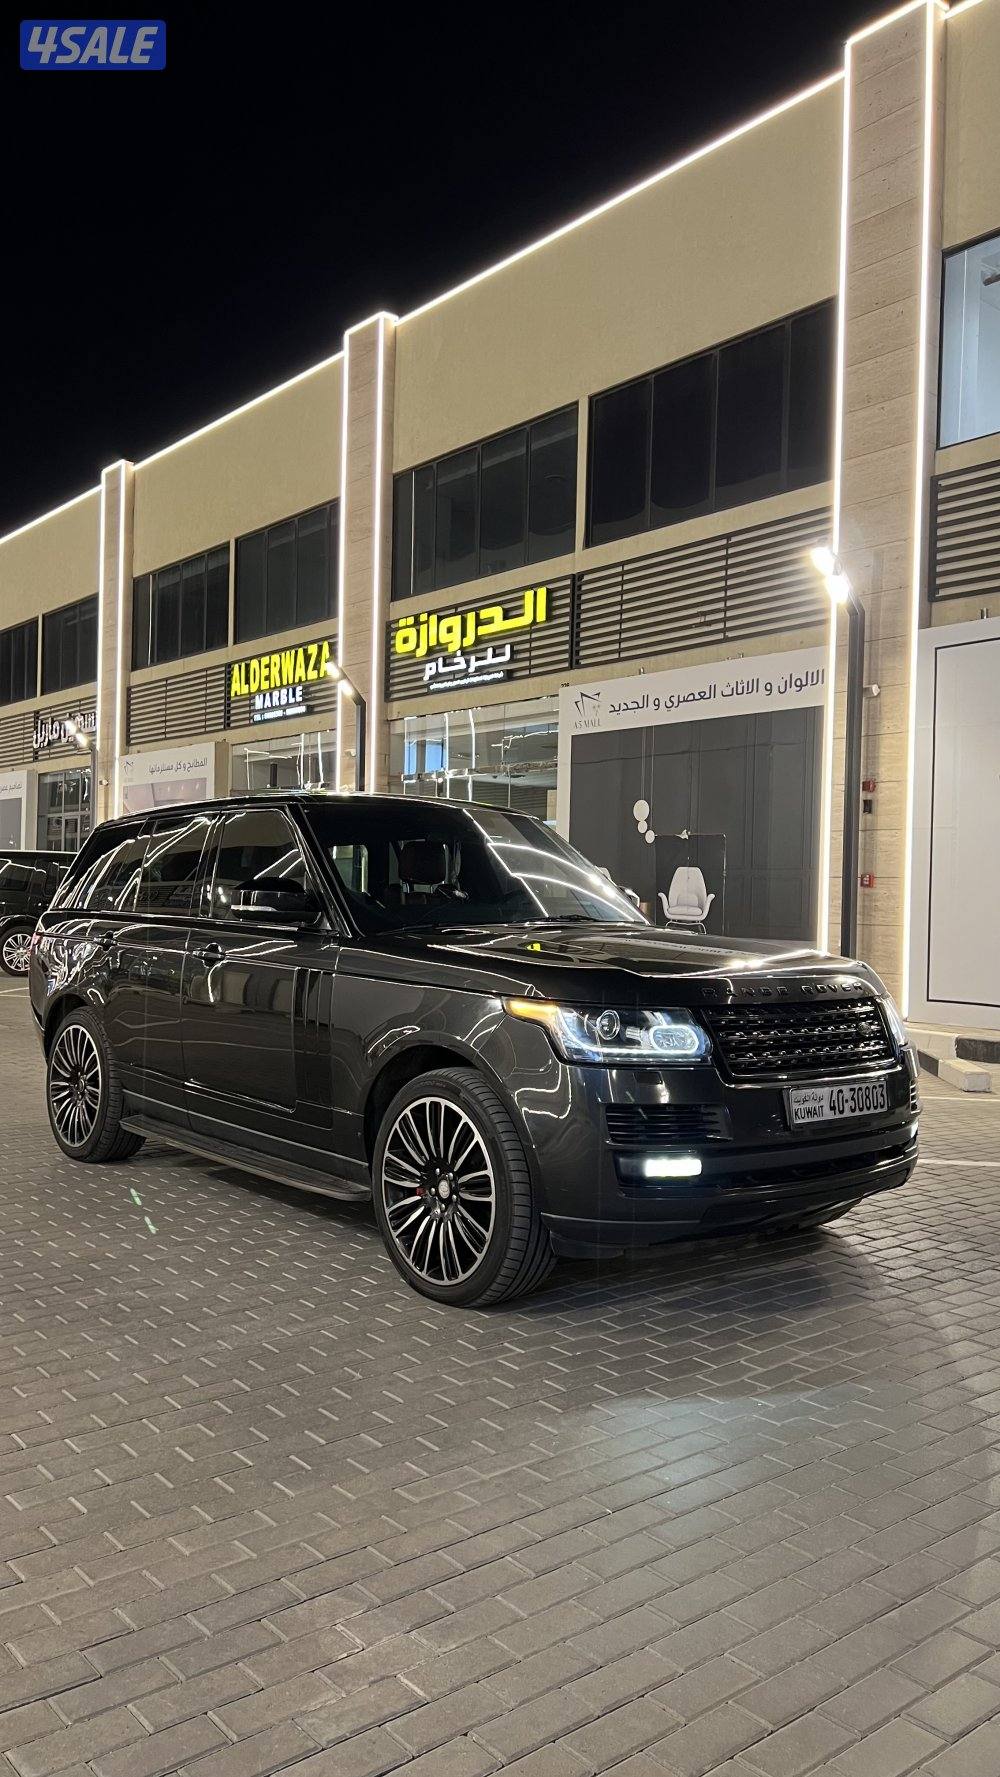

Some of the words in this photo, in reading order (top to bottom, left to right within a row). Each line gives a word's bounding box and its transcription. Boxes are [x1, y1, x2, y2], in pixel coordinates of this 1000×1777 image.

[395, 586, 547, 658] الدروازة
[230, 640, 330, 697] ALDERWAZA
[423, 643, 511, 681] للرخام
[721, 677, 760, 698] الاثاث
[764, 682, 773, 696] و
[777, 668, 825, 695] الالوان
[254, 685, 303, 710] MARBLE
[608, 694, 649, 715] الجديد
[653, 697, 661, 711] و
[664, 683, 717, 712] العصري
[701, 986, 789, 998] RANGE
[801, 981, 864, 995] ROVER
[829, 1083, 886, 1116] 40-30803
[794, 1105, 824, 1120] KUWAIT
